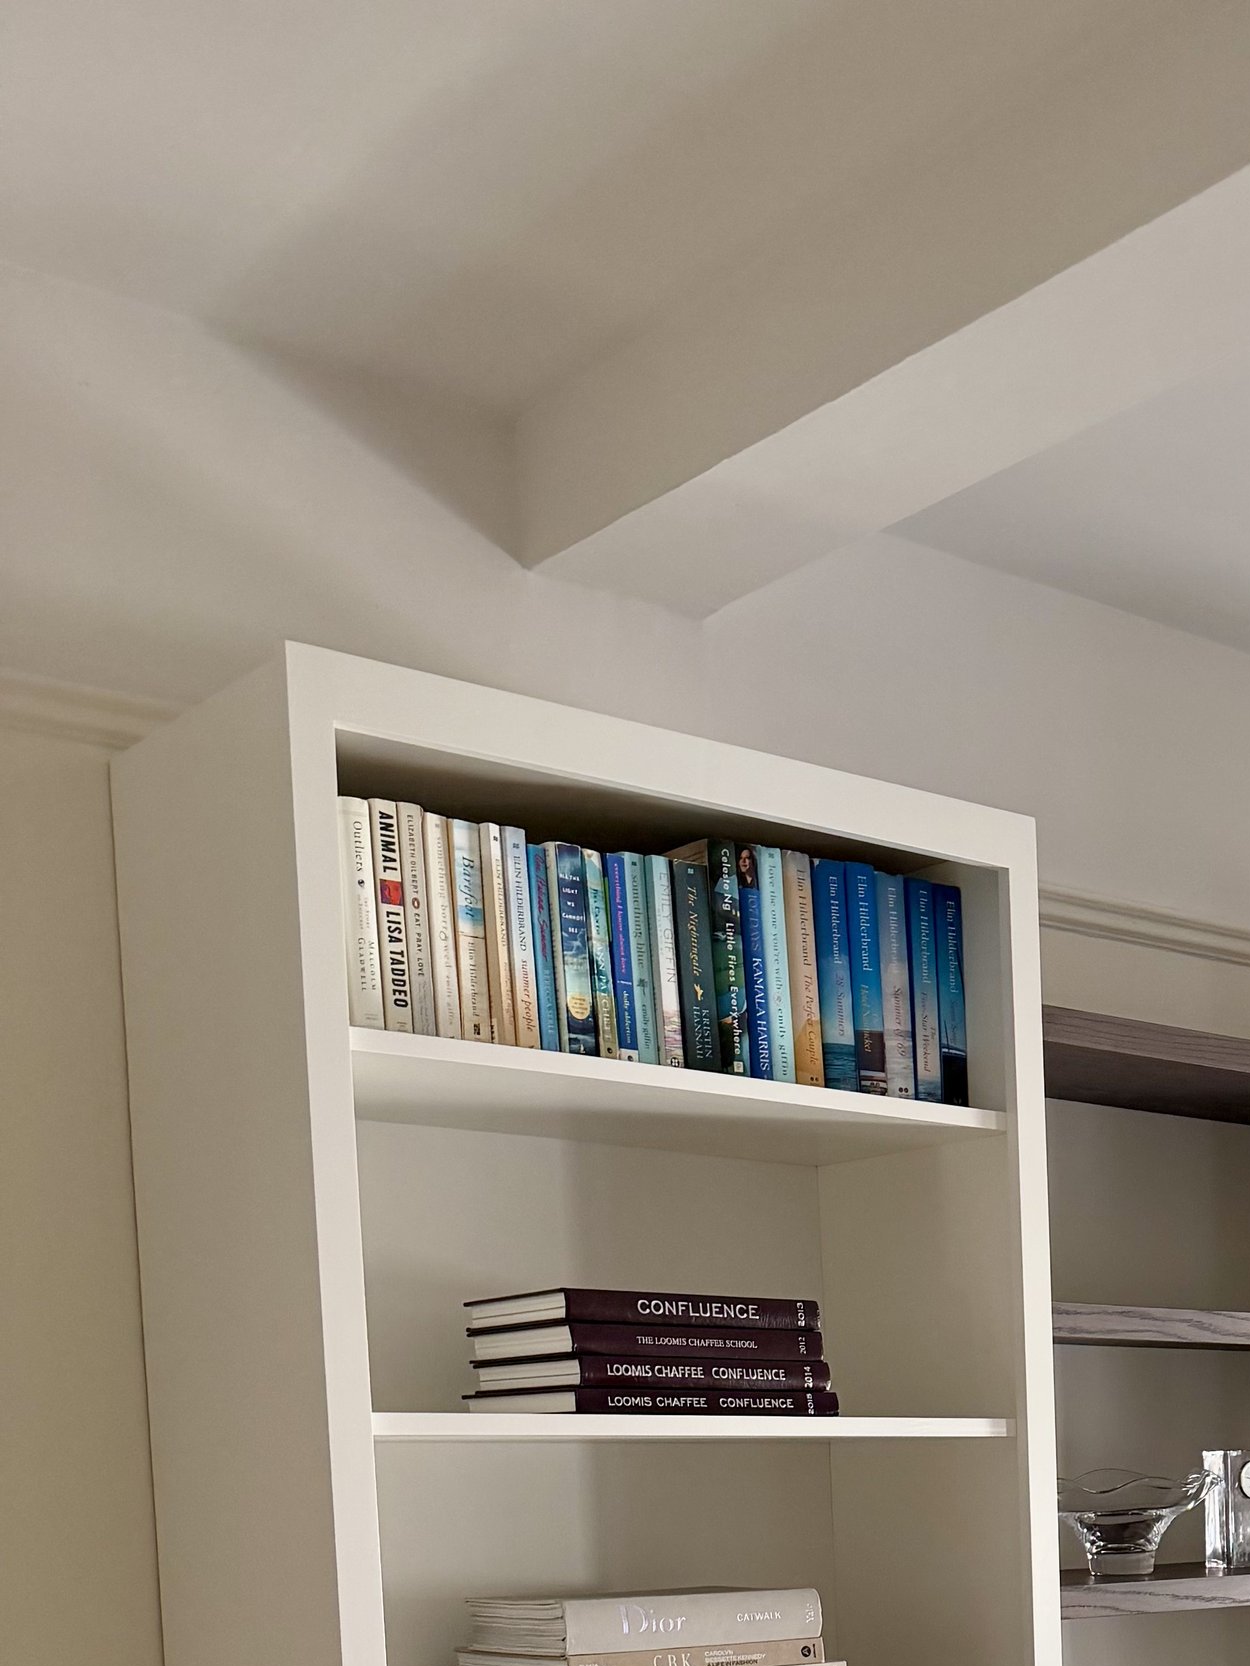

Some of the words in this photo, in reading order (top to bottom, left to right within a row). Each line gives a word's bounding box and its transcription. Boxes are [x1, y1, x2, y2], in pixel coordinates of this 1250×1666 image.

[352, 820, 363, 873] Outliers
[378, 810, 398, 873] ANIMAL
[406, 814, 417, 859] ELIZABETH
[410, 860, 420, 895] GILBERT
[512, 855, 523, 880] ELIN
[721, 848, 730, 891] Celeste
[767, 863, 775, 889] love
[796, 869, 806, 892] Elin
[458, 856, 479, 919] Barefoot
[659, 871, 671, 918] EMILY
[687, 886, 698, 907] The
[829, 875, 838, 897] Elin
[857, 874, 867, 899] Elin
[887, 886, 896, 912] Elin
[919, 889, 928, 914] Elin
[514, 880, 528, 952] HILDERBRAND
[631, 875, 645, 939] something
[722, 893, 733, 916] Ng
[946, 900, 955, 923] Elin
[386, 910, 403, 944] LISA
[688, 910, 703, 978] Nightingale
[726, 922, 734, 951] Little
[798, 894, 812, 967] Hilderbrand
[830, 899, 842, 965] Hilderbrand
[859, 901, 873, 972] Hilderbrand
[467, 941, 477, 960] Elin
[595, 943, 606, 971] ANN
[636, 940, 644, 967] blue
[663, 927, 677, 984] GIFFIN
[888, 913, 900, 976] Hilderbrand
[921, 915, 931, 985] Hilderbrand
[948, 924, 960, 994] Hilderbrand
[357, 937, 367, 991] GLADWELL
[389, 949, 409, 1009] TADDEO
[521, 958, 531, 997] summer
[729, 953, 737, 982] Fires
[469, 963, 480, 1017] Hilderbrand
[752, 957, 766, 1017] KAMALA
[803, 974, 812, 994] The
[520, 1000, 534, 1032] people
[730, 986, 741, 1056] Everywhere
[836, 990, 846, 1038] Summers
[693, 1006, 703, 1060] HANNAH
[702, 1008, 712, 1059] KRISTIN
[757, 1019, 770, 1071] HARRIS
[806, 1030, 817, 1066] Couple
[636, 1299, 760, 1320] CONFLUENCE
[797, 1302, 805, 1327] 2013
[636, 1336, 654, 1346] THE
[655, 1337, 687, 1348] LOOMIS
[688, 1338, 725, 1349] CHAFFEE
[726, 1339, 758, 1350] SCHOOL
[607, 1363, 653, 1378] LOOMIS
[654, 1365, 704, 1379] CHAFFEE
[711, 1366, 786, 1382] CONFLUENCE
[805, 1365, 814, 1389] 2014
[608, 1396, 653, 1408] LOOMIS
[656, 1396, 707, 1408] CHAFFEE
[719, 1397, 794, 1409] CONFLUENCE
[807, 1394, 815, 1415] 2015
[615, 1604, 687, 1635] Dior
[736, 1611, 781, 1623] CATWALK
[732, 1659, 759, 1666] FASHION
